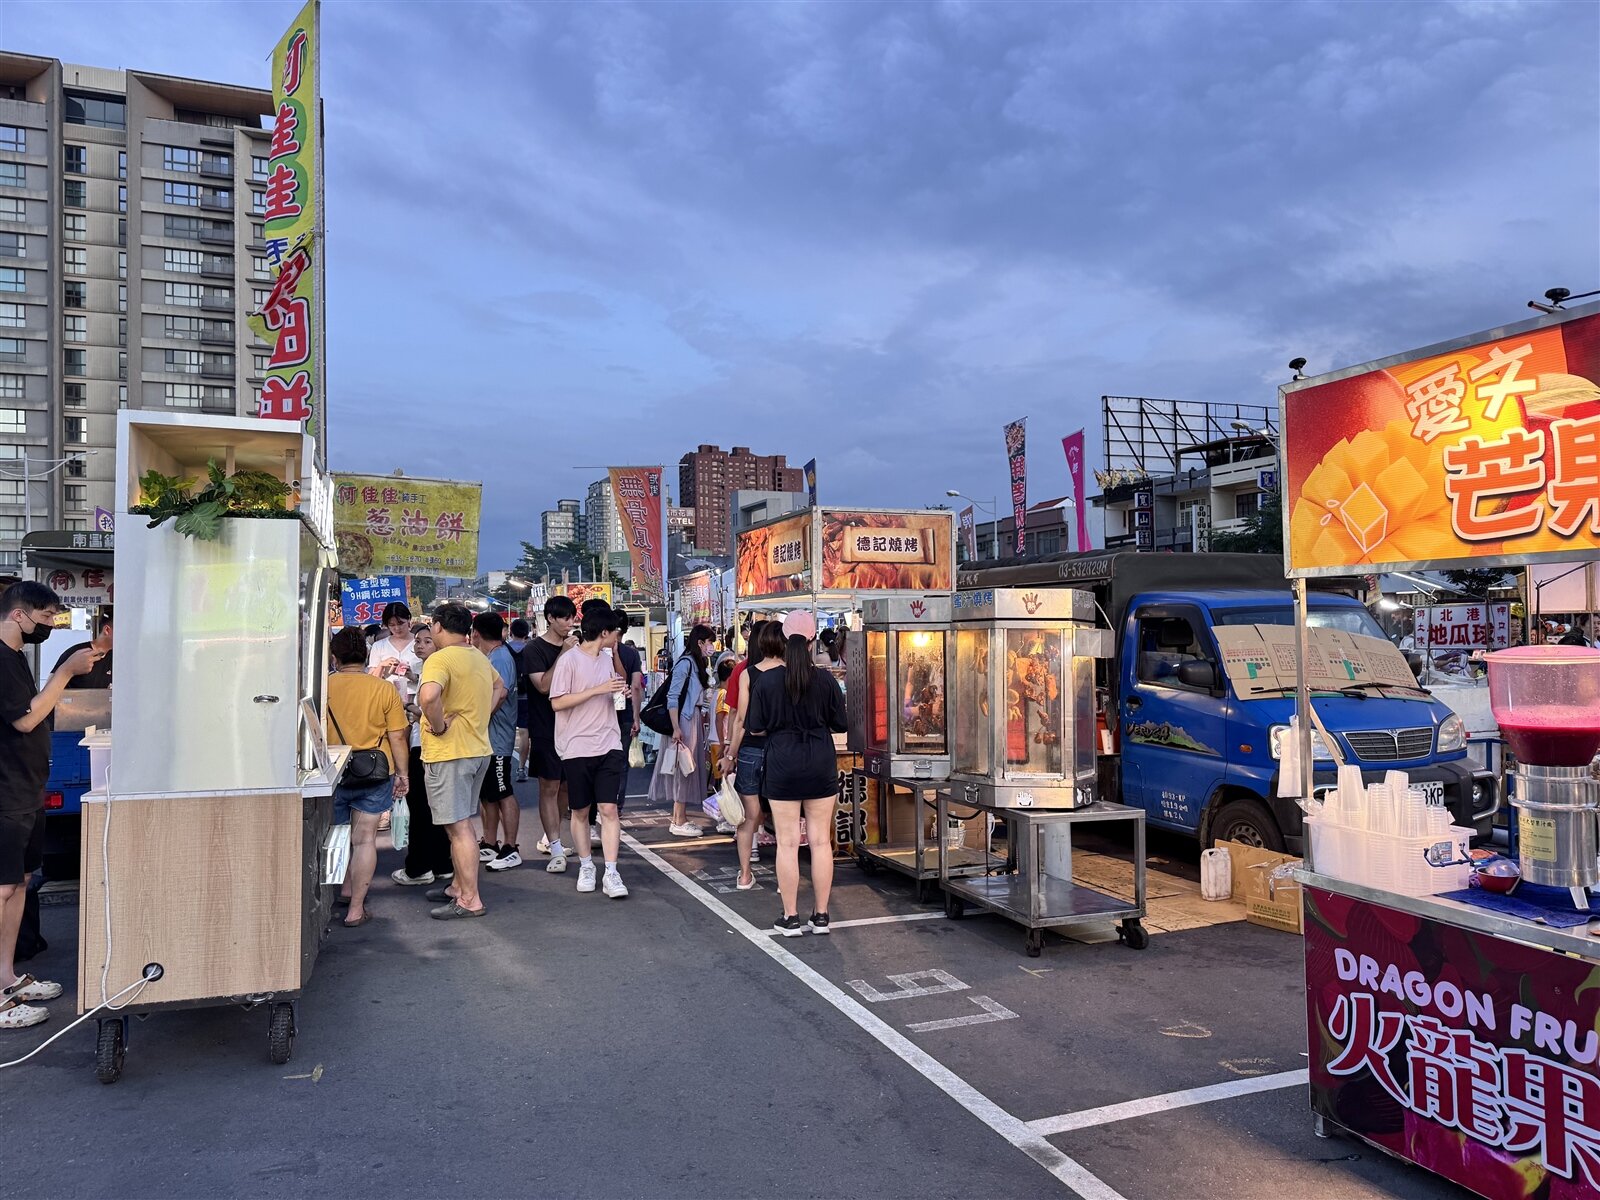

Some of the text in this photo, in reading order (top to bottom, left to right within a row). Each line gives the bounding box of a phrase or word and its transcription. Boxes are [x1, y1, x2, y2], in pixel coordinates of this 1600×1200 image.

[1404, 343, 1537, 443] 愛文
[337, 485, 427, 506] 何佳佳 純手工
[100, 516, 113, 531] 我
[773, 541, 802, 565] 德記燒烤
[857, 535, 919, 553] 德記燒烤
[1058, 560, 1108, 578] 03-5328298
[359, 577, 390, 589] 全型號
[953, 591, 993, 609] 蜜汁燒烤
[353, 601, 390, 624] $5
[1440, 607, 1480, 622] 北港
[1428, 622, 1496, 646] 地瓜球
[835, 769, 868, 845] 德記
[1334, 947, 1600, 1064] DRAGON FRU
[1327, 992, 1600, 1192] 火龍果
